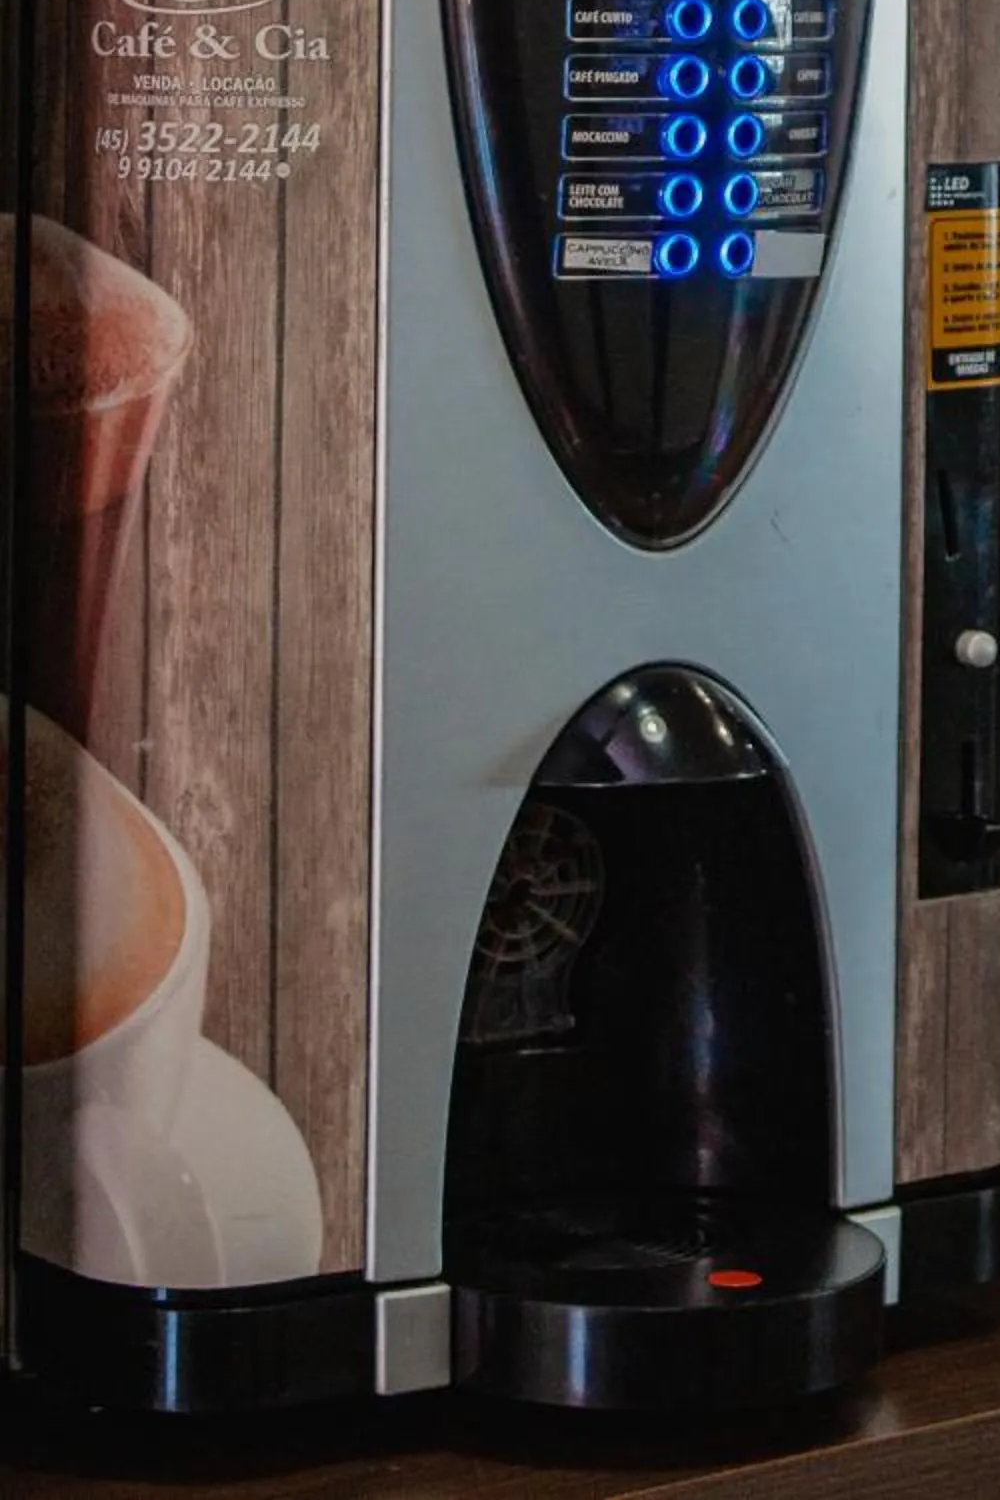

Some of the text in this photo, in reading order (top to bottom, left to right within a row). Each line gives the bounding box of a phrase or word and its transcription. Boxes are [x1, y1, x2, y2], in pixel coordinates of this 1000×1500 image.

[575, 10, 633, 24] CAFÉ CURTO
[91, 20, 331, 61] Café & Cia
[132, 73, 276, 94] VENDA LOCAÇÃO
[569, 69, 594, 83] CAFÉ
[94, 121, 322, 155] (45) 3522-2144
[572, 131, 630, 144] MOCACCINO
[117, 155, 272, 183] 9 9104 2144
[569, 184, 620, 197] LEITE COM
[569, 195, 624, 210] CHOCOLATE
